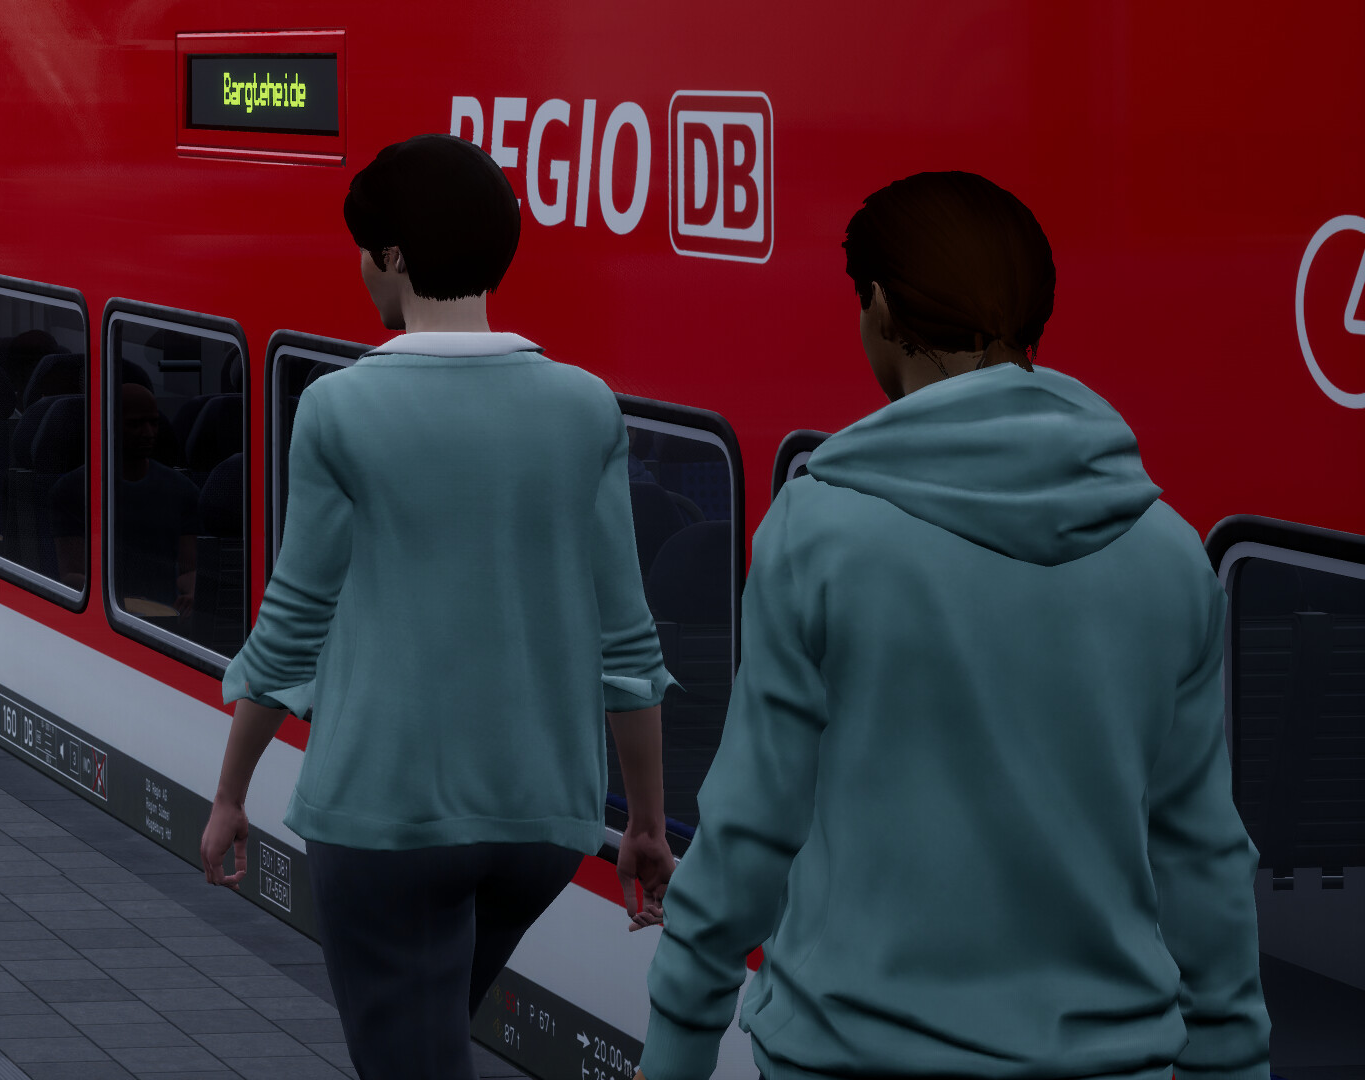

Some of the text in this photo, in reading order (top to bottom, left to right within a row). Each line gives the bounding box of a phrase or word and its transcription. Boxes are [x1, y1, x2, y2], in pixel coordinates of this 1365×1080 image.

[223, 72, 306, 114] Bargteheide
[683, 121, 759, 230] DB
[3, 704, 17, 738] 160
[24, 715, 33, 748] DB
